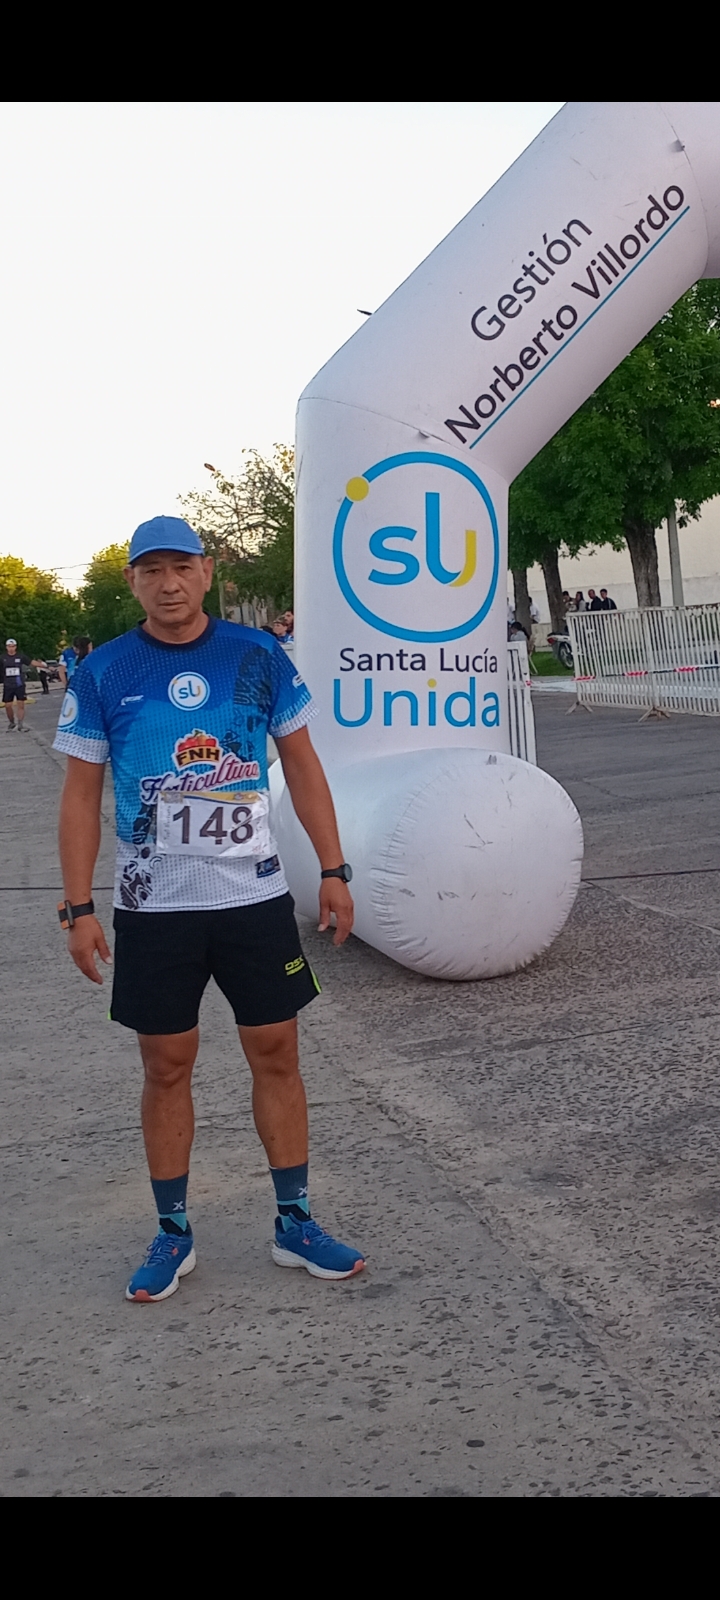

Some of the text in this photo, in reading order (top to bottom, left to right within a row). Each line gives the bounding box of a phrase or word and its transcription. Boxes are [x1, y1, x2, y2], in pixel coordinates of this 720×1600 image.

[471, 219, 592, 341] Gestión
[444, 185, 685, 444] Norberto Villordo
[339, 647, 498, 673] Santa Lucía
[333, 676, 500, 728] Unida
[175, 747, 220, 767] FNH
[172, 805, 254, 845] 148
